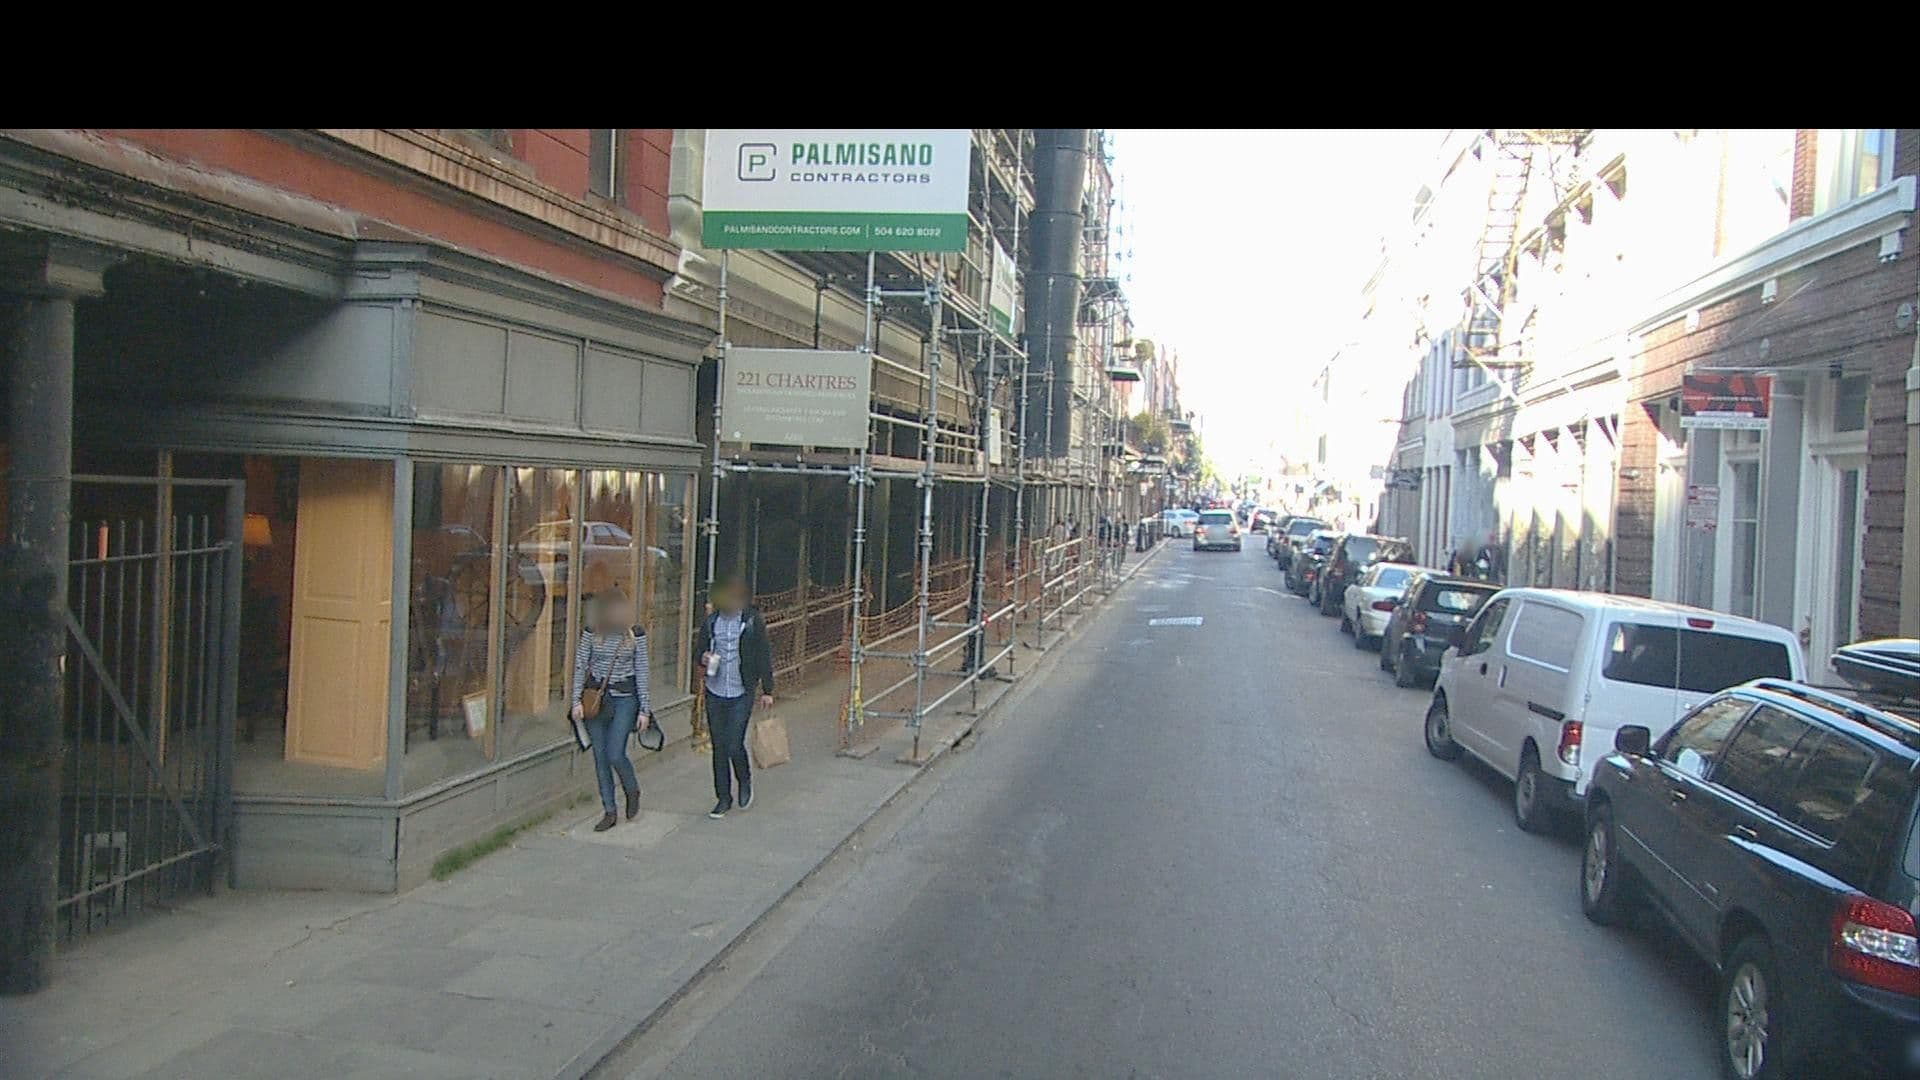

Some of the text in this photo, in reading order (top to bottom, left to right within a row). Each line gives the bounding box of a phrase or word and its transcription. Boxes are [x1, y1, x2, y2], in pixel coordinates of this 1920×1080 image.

[792, 143, 933, 165] PALMISANO
[790, 172, 931, 184] CONTRACTORS
[724, 224, 861, 236] PALMISANOCONTRACTORS.COM
[874, 226, 893, 236] 504
[895, 226, 914, 236] 620
[736, 371, 857, 390] 221 CHARTRES
